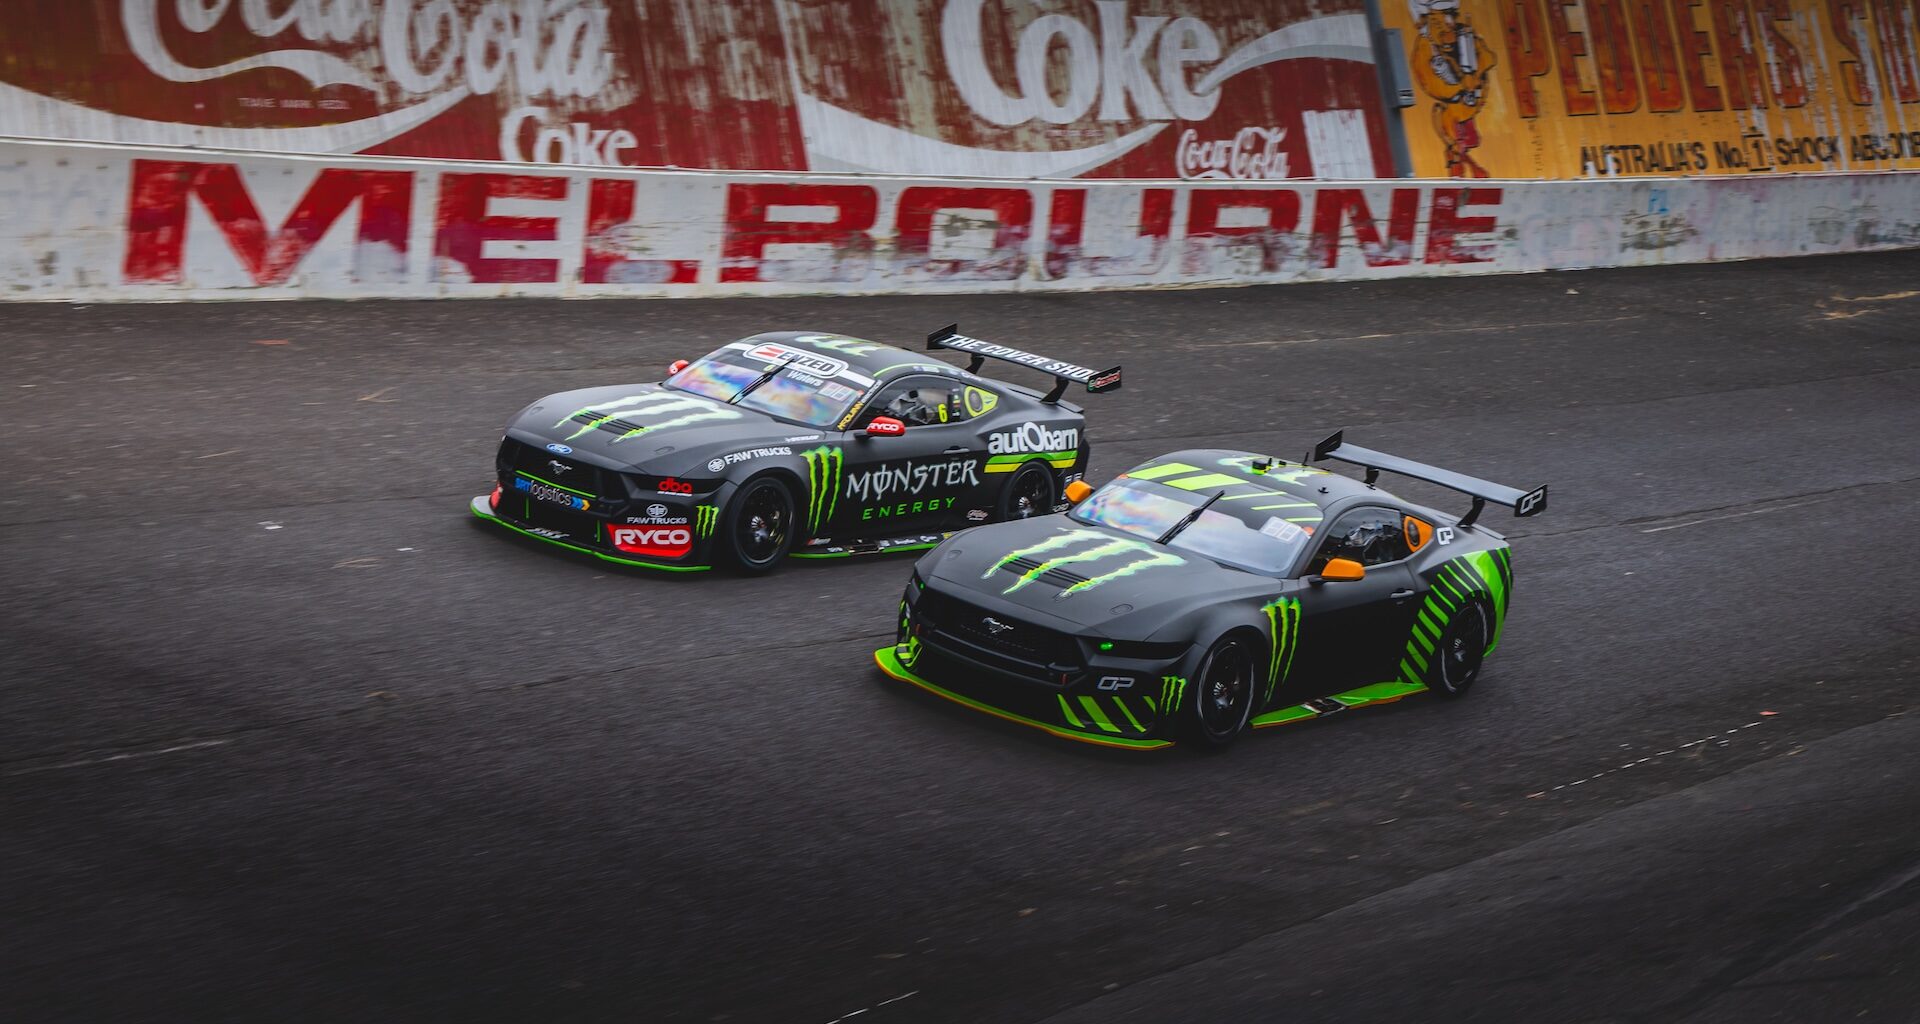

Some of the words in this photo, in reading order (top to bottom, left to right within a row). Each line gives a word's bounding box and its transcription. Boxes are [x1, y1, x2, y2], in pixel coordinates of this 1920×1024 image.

[501, 106, 638, 166] Coke
[1580, 141, 1709, 176] AUSTRALIA'S
[1775, 135, 1842, 166] SHOCK
[122, 158, 1504, 286] MELBOURNE
[943, 334, 987, 349] THE
[979, 344, 1044, 365] COVER
[776, 351, 836, 374] ENZED
[786, 370, 824, 387] Waters
[938, 403, 948, 423] 6
[724, 451, 752, 465] FAW
[751, 446, 792, 458] TRUCKS
[862, 497, 956, 520] ENERGY
[627, 516, 648, 524] FAW
[647, 516, 688, 525] TRUCKS
[614, 528, 691, 546] RYCO
